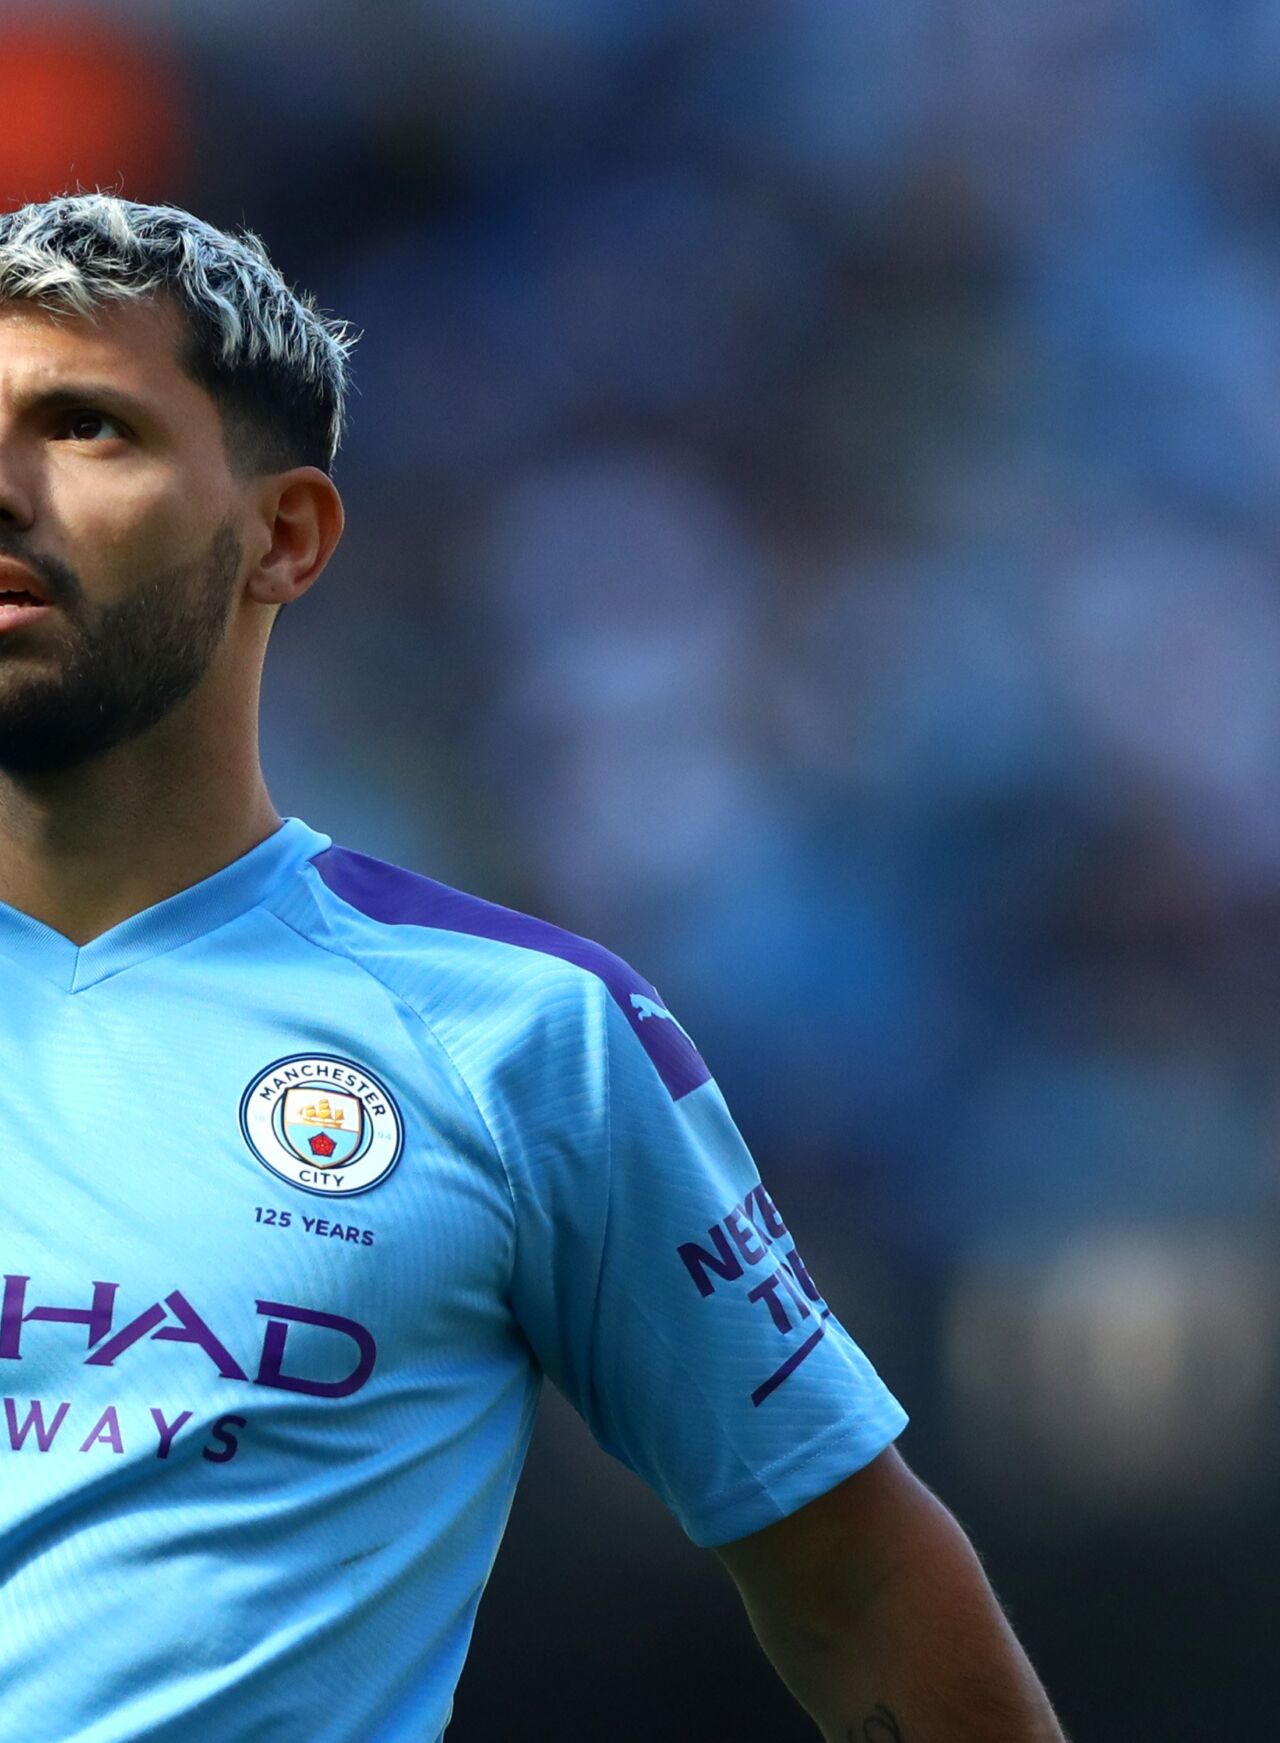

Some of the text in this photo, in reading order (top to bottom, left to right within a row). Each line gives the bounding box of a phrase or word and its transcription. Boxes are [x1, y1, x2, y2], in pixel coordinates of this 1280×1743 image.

[259, 1065, 386, 1117] MANCHESTER
[298, 1170, 345, 1187] CITY
[254, 1206, 375, 1247] 125 YEARS
[676, 1184, 787, 1298] NEXE
